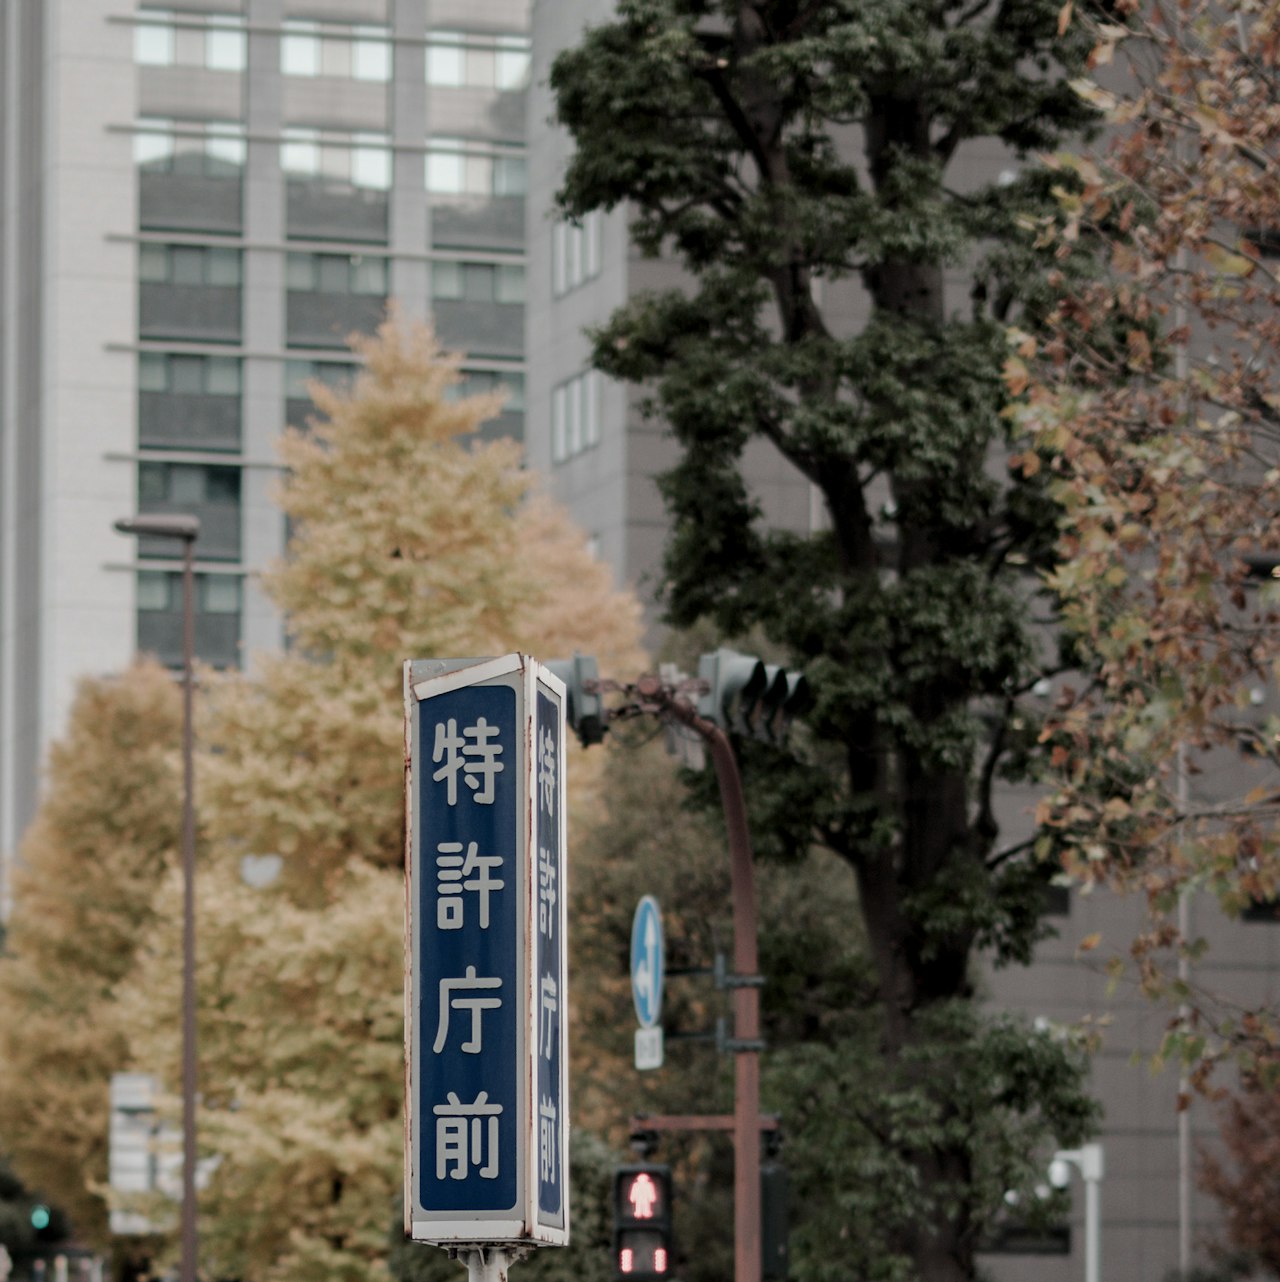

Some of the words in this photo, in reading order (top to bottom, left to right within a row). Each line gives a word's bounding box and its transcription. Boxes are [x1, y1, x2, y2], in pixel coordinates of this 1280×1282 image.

[432, 716, 505, 1181] 特許庁前
[538, 724, 557, 1185] 特許庁前
